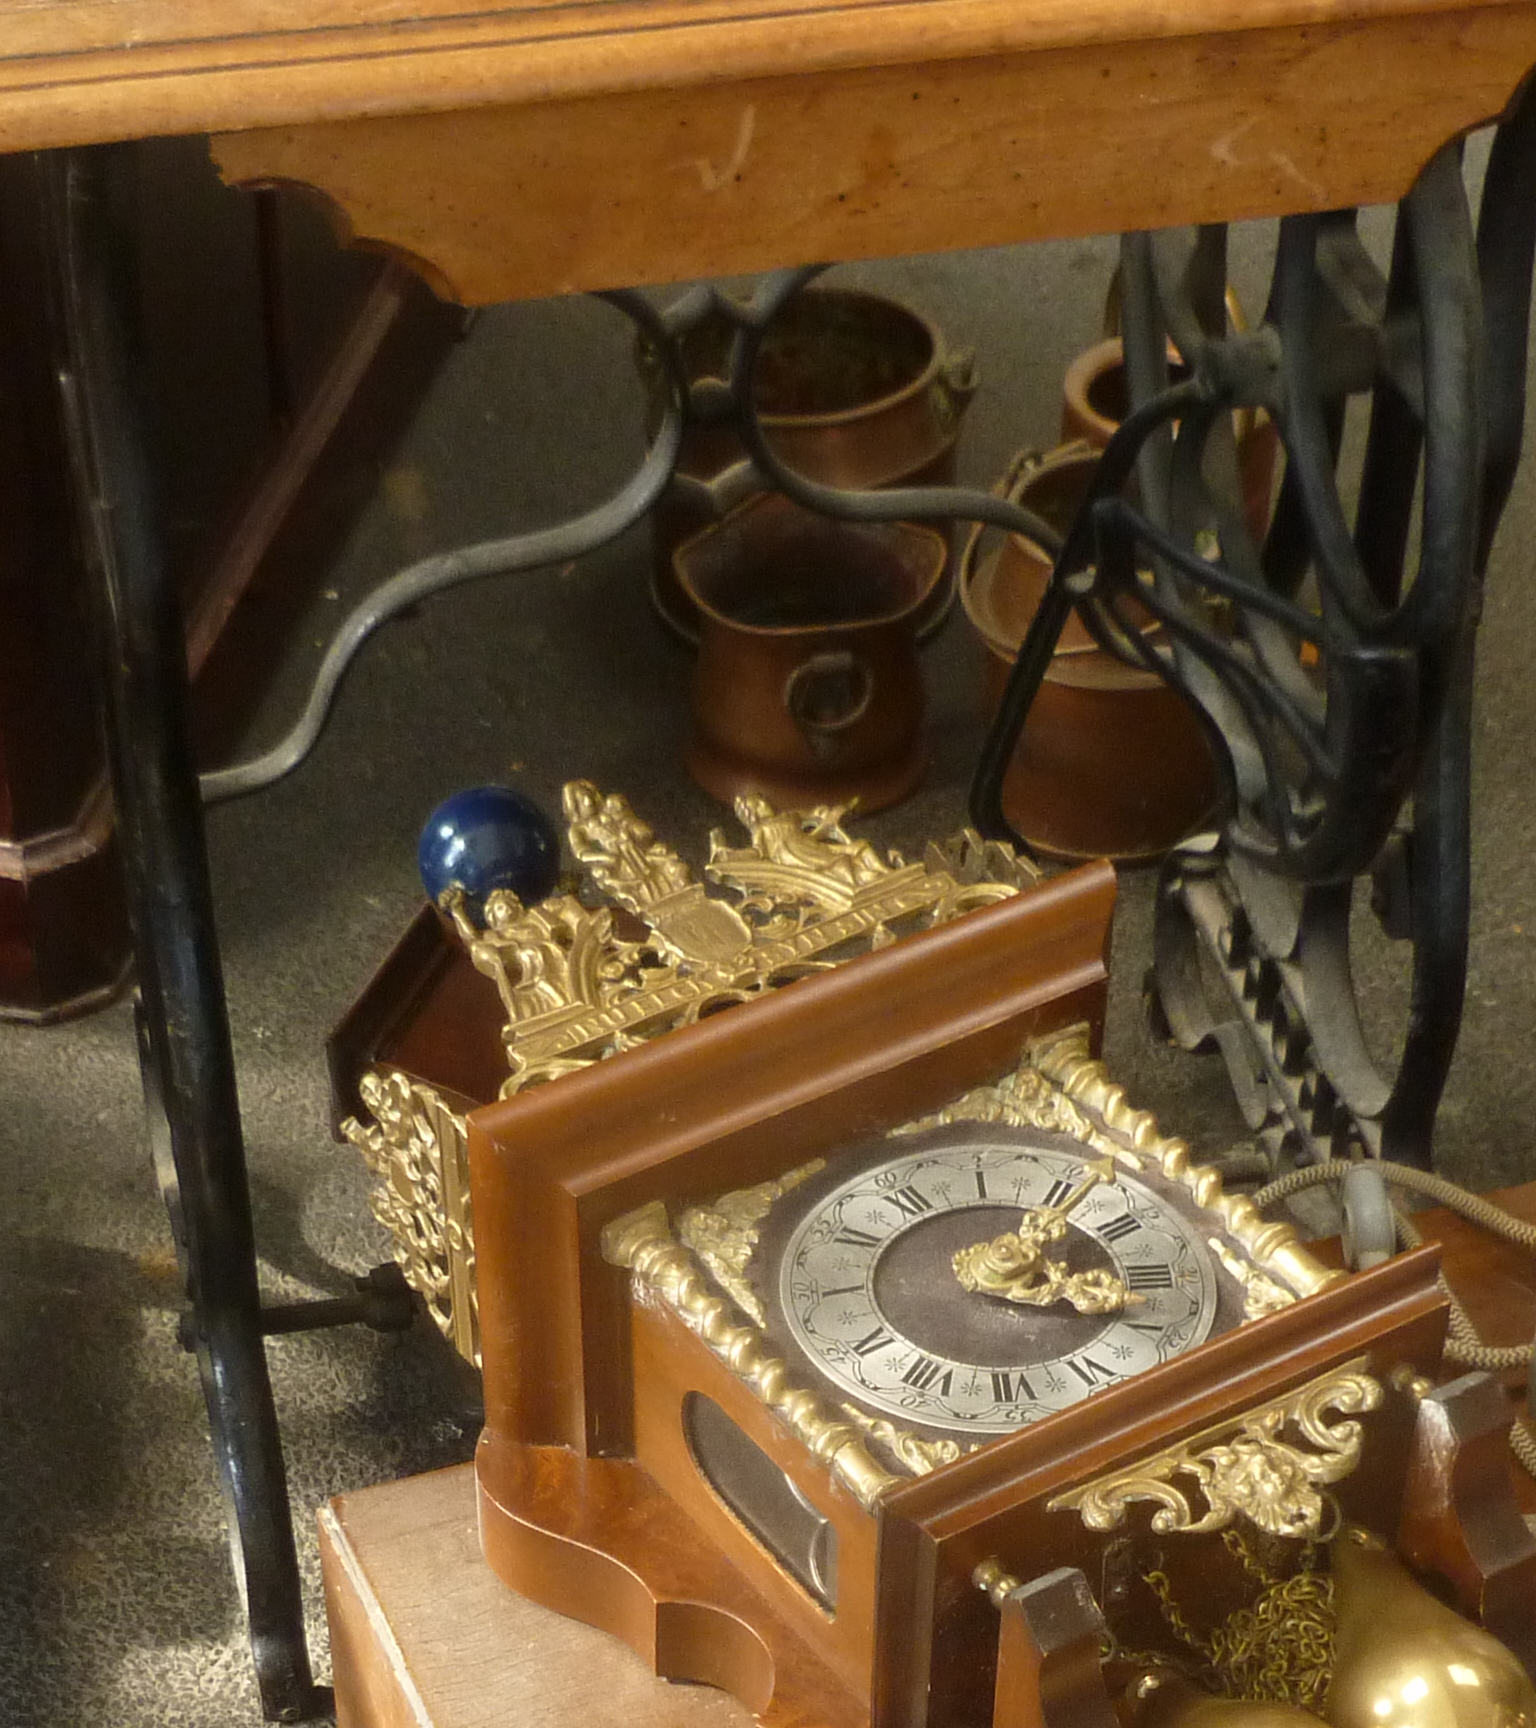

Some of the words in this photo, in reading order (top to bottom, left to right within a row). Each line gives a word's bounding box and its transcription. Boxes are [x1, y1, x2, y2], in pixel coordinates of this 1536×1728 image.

[874, 1171, 898, 1190] 60
[884, 1184, 934, 1220] XII
[810, 1217, 831, 1238] 55
[1096, 1212, 1143, 1243] III
[1125, 1263, 1174, 1291] IIII
[793, 1282, 811, 1301] 50
[821, 1346, 847, 1365] 45
[901, 1353, 954, 1397] VIII
[990, 1372, 1039, 1403] VII
[900, 1393, 933, 1409] 40
